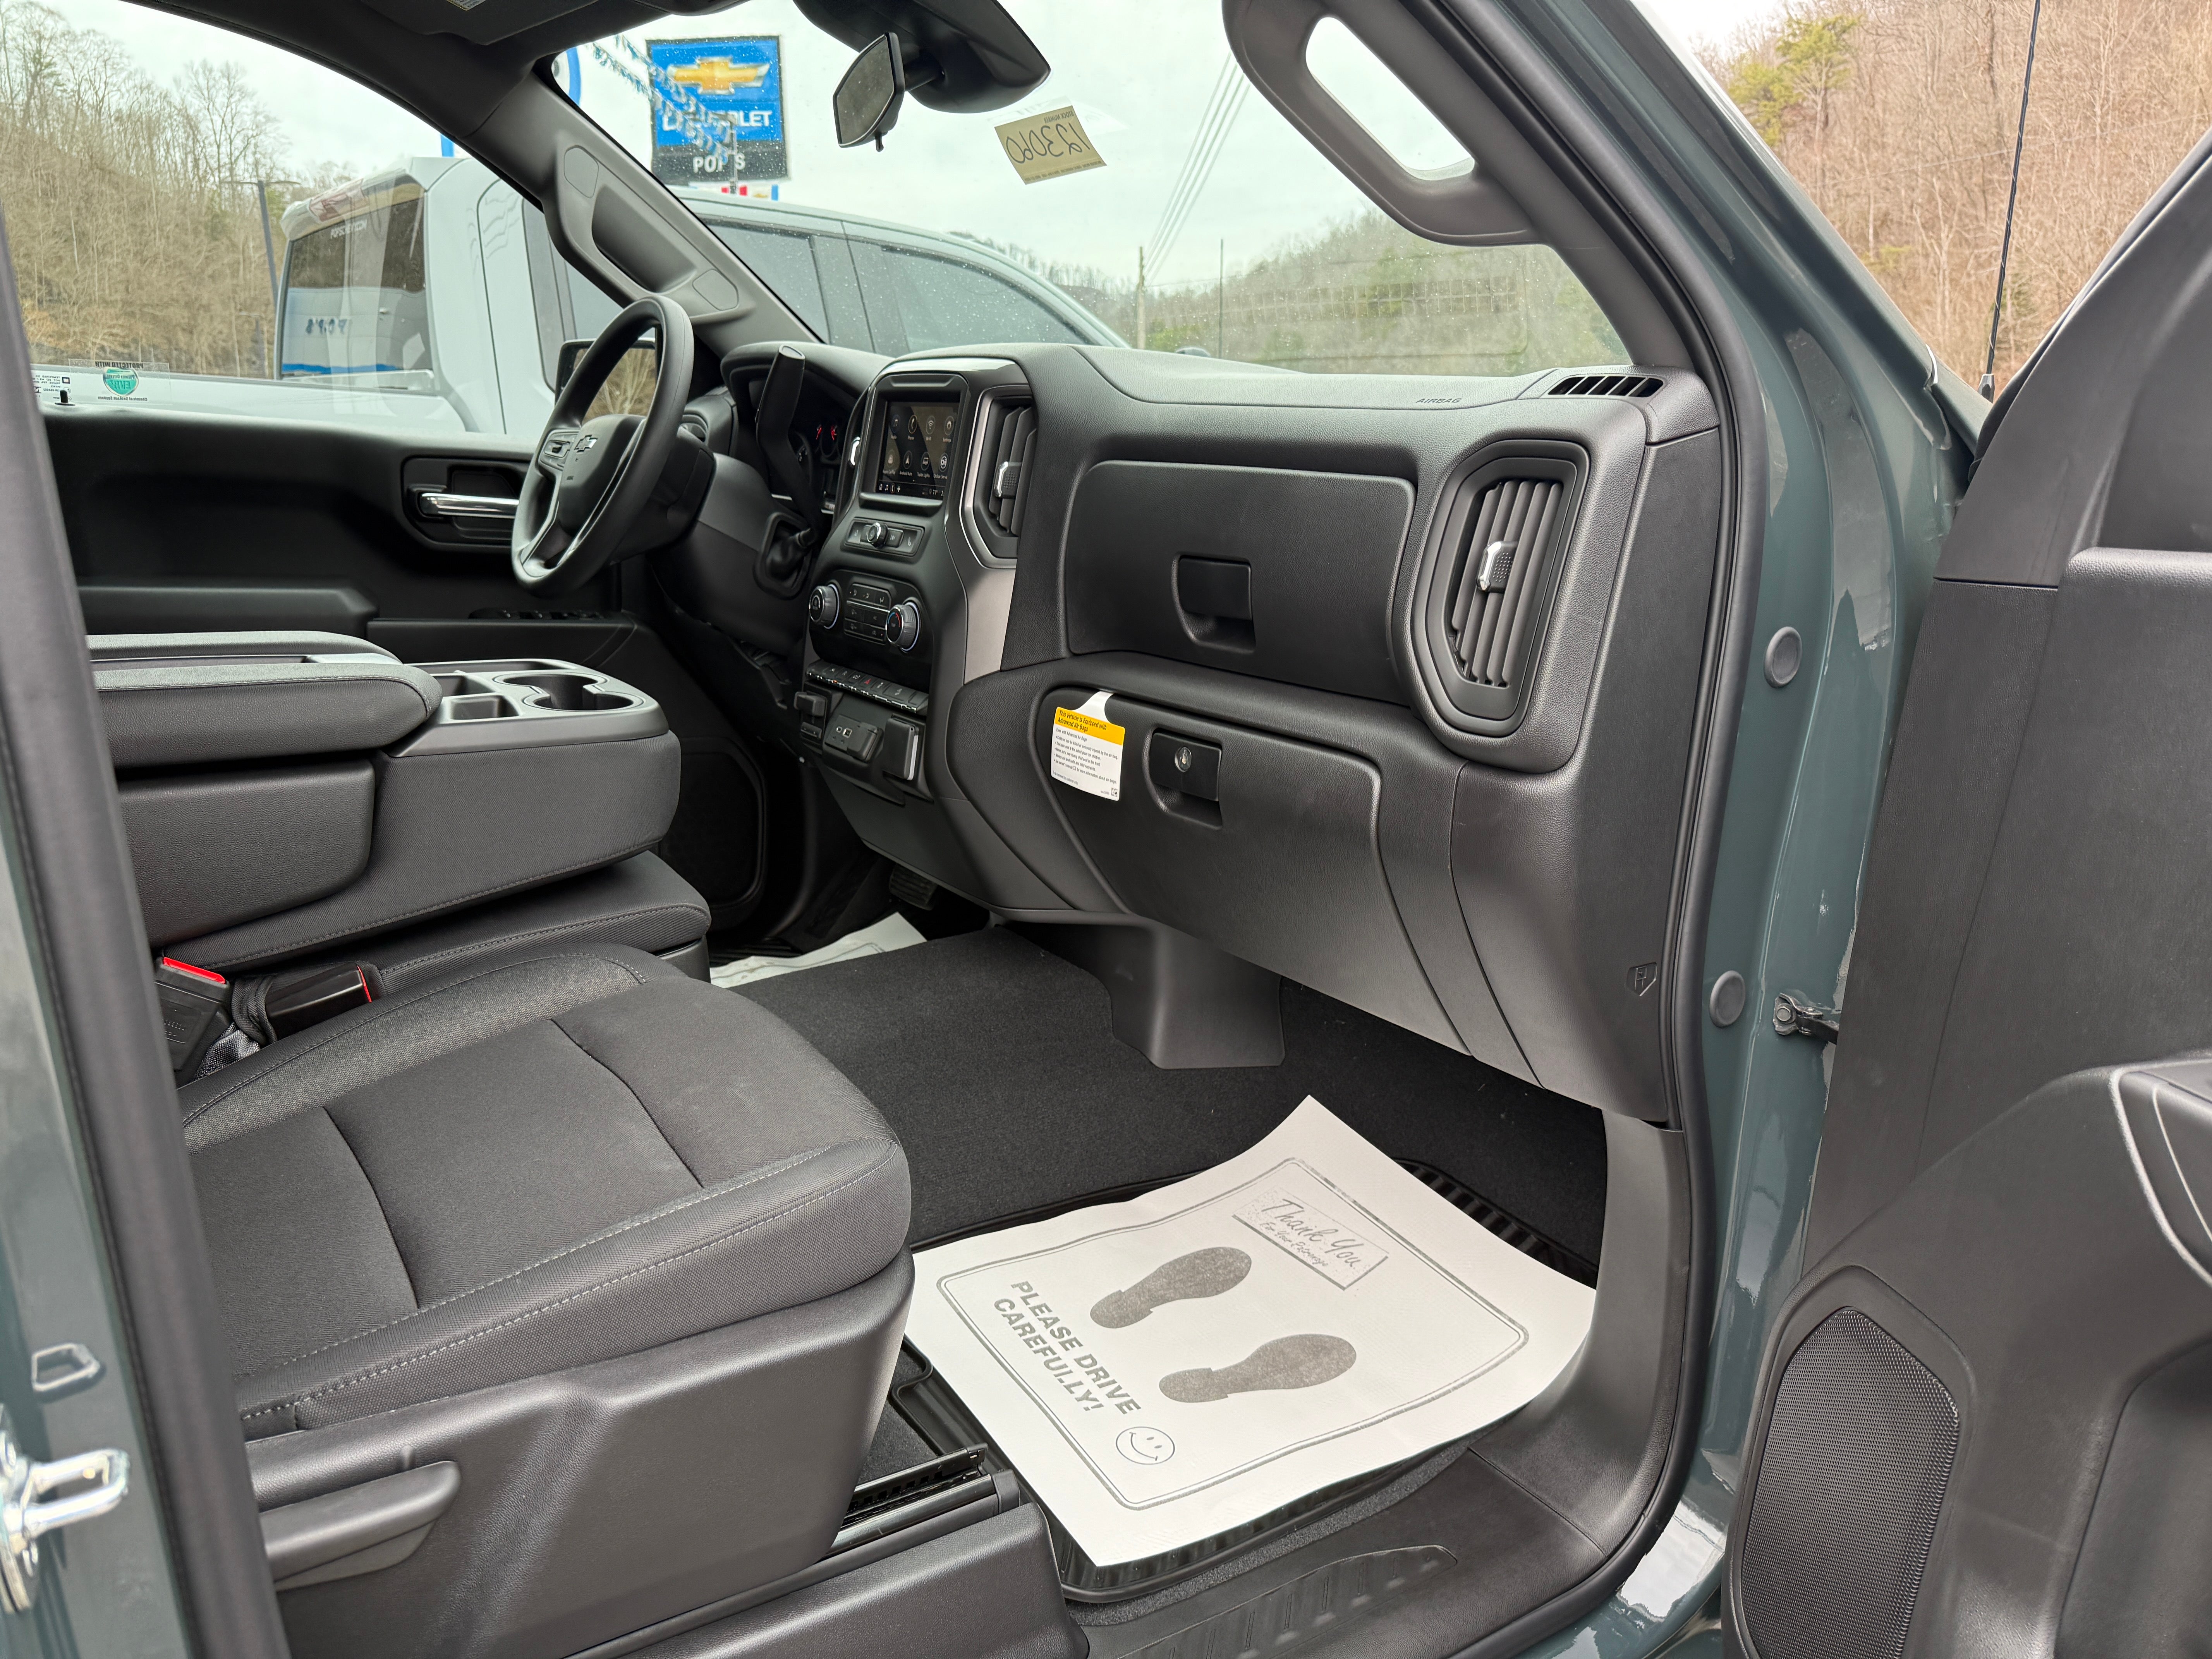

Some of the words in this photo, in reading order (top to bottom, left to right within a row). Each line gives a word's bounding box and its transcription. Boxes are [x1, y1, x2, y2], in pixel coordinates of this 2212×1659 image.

[1058, 717, 1073, 727] Advanced
[1079, 724, 1088, 733] Bags
[1067, 712, 1079, 721] Vehicle
[1083, 717, 1099, 728] Equipped
[1261, 1199, 1338, 1242] Thank
[994, 1298, 1104, 1411] CAREFULLY!
[1011, 1281, 1083, 1351] PLEASE
[1073, 1353, 1142, 1414] DRIVE
